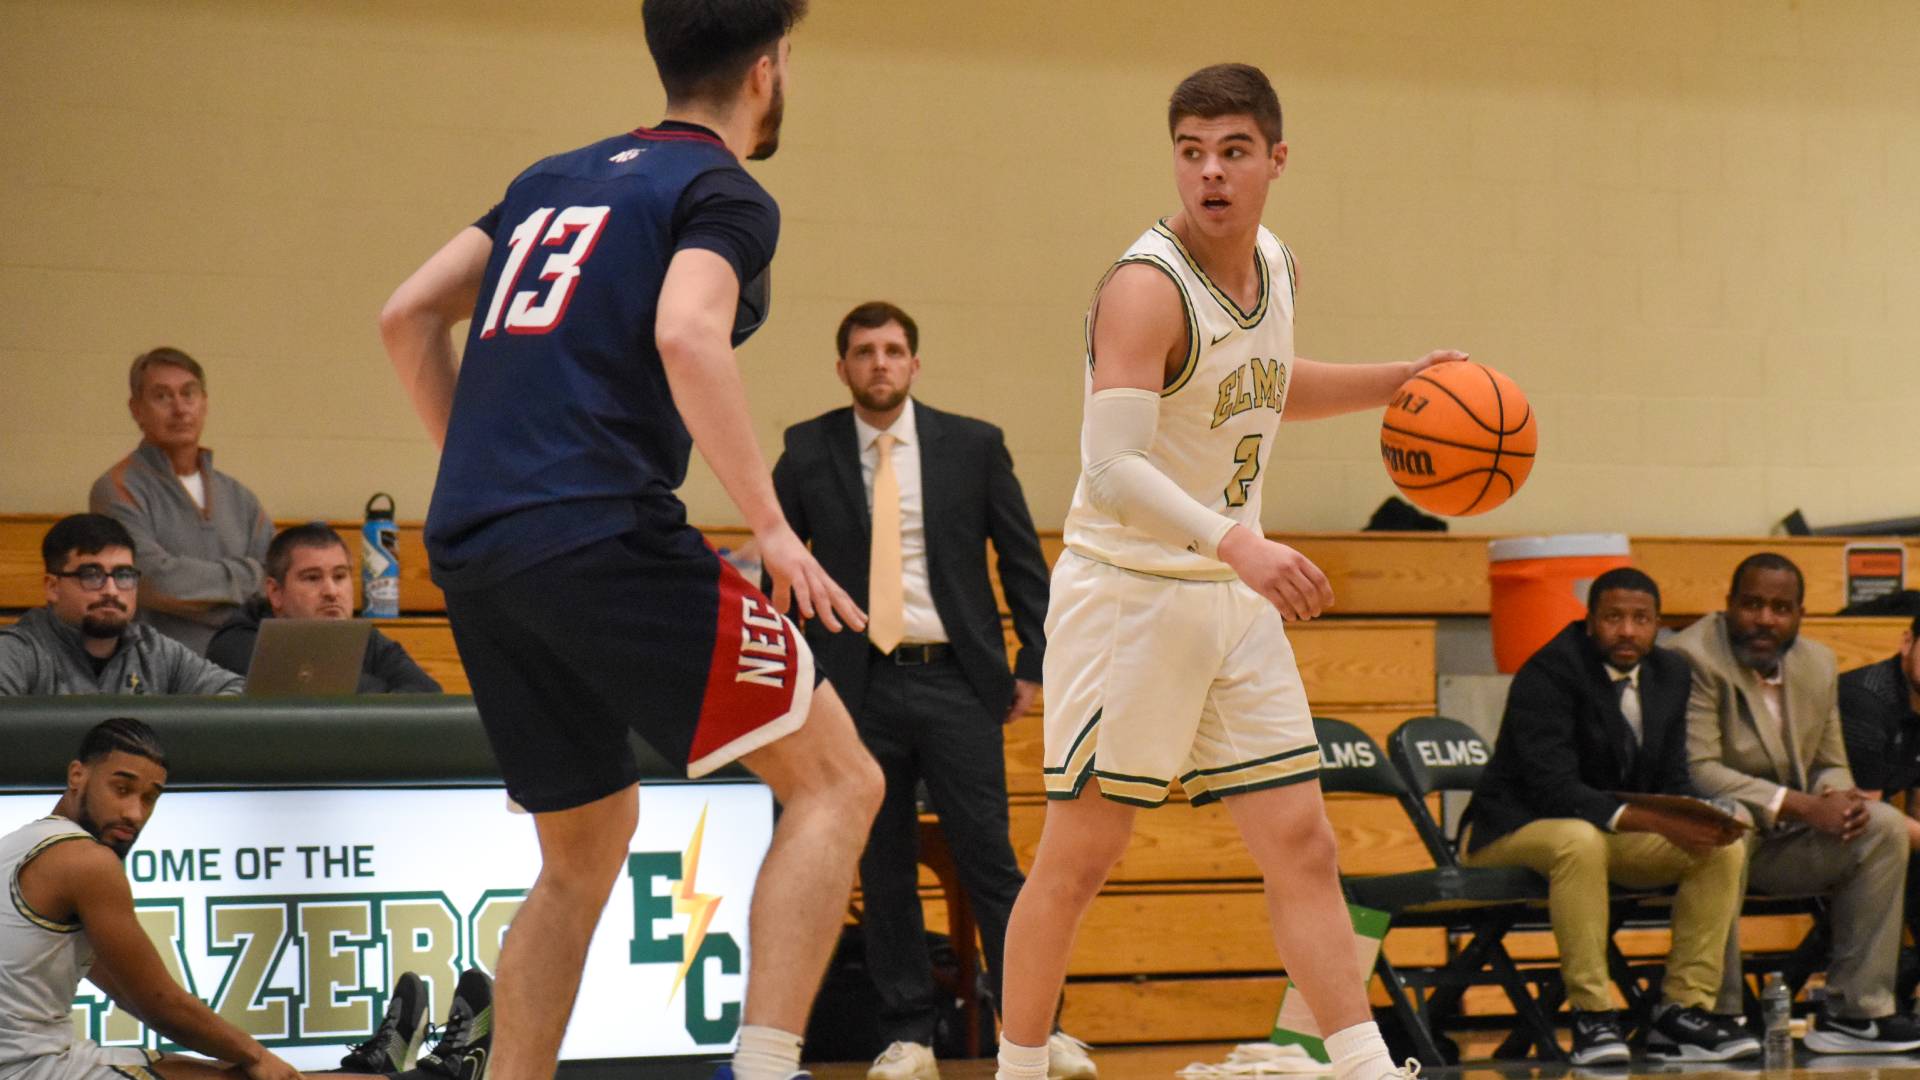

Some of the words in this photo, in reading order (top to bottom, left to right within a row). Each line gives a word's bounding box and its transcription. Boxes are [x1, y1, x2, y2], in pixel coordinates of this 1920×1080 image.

[479, 205, 611, 339] 13
[1210, 356, 1287, 430] ELMS
[1223, 432, 1264, 508] 2
[735, 595, 788, 689] NEC
[1319, 741, 1377, 768] LMS
[1415, 740, 1489, 766] ELMS
[125, 848, 221, 883] OME
[235, 846, 286, 880] OF
[297, 844, 376, 878] THE
